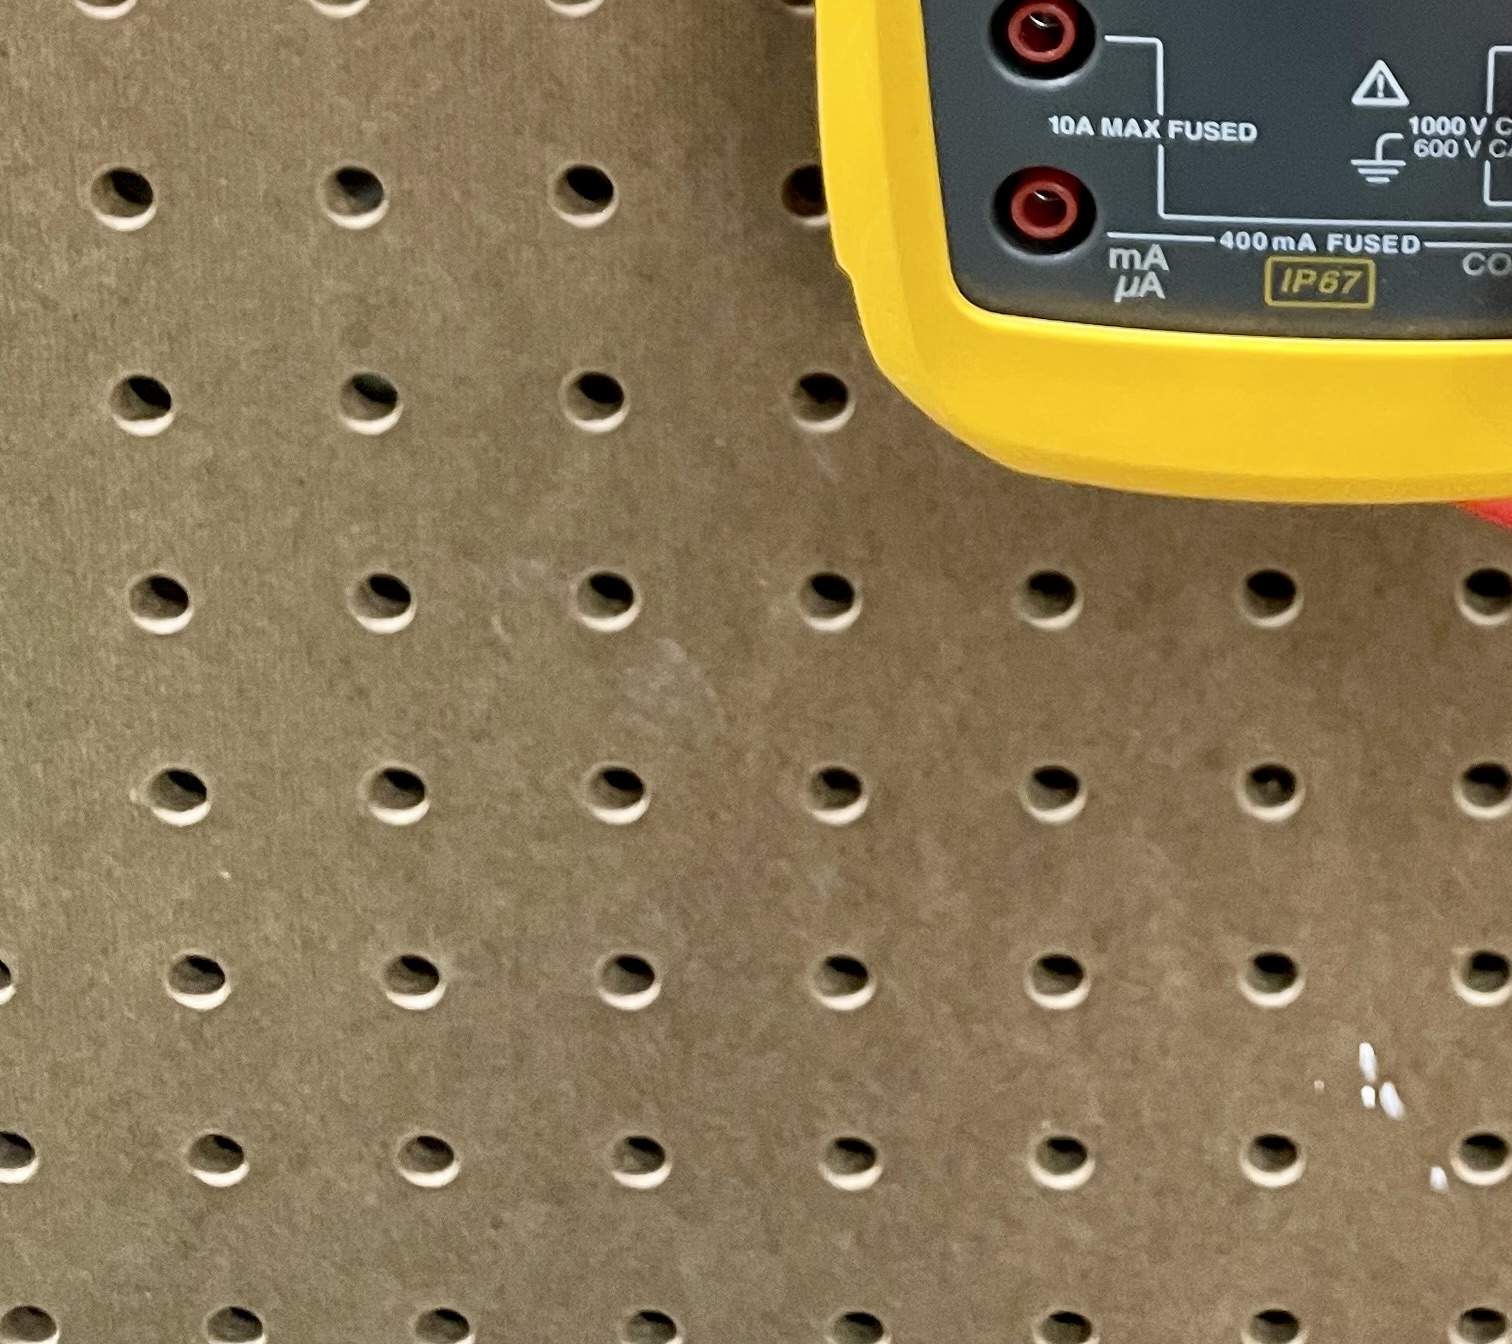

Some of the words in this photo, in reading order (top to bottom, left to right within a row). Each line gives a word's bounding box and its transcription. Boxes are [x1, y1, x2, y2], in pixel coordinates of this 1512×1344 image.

[1048, 115, 1095, 136] 10A
[1101, 117, 1161, 139] MAX
[1167, 119, 1258, 142] FUSED
[1413, 138, 1459, 158] 600
[1463, 138, 1482, 158] V
[1109, 243, 1170, 272] mA
[1326, 233, 1422, 255] FUSED
[1279, 267, 1363, 295] IP67
